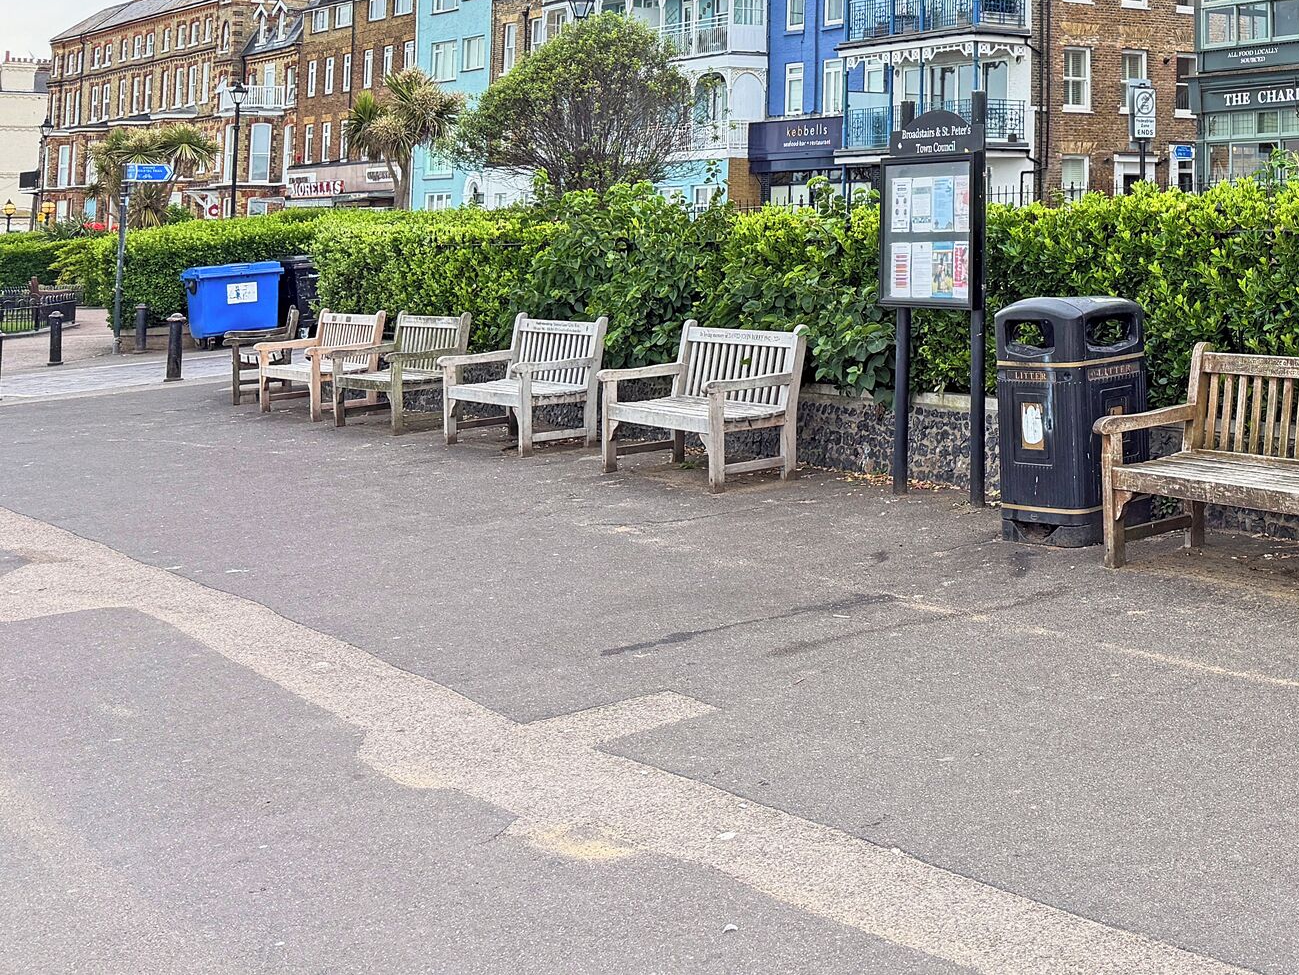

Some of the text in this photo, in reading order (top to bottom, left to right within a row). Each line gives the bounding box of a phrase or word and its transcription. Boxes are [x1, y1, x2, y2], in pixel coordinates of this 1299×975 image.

[1255, 47, 1278, 55] LOCALLY
[1224, 92, 1250, 107] THE
[786, 124, 828, 137] kebbells
[902, 128, 935, 140] Broadstairs
[936, 127, 941, 137] &
[951, 125, 971, 136] Peter's
[916, 141, 956, 153] Town Council
[1015, 371, 1046, 380] LITTER
[1098, 365, 1132, 376] LITTER
